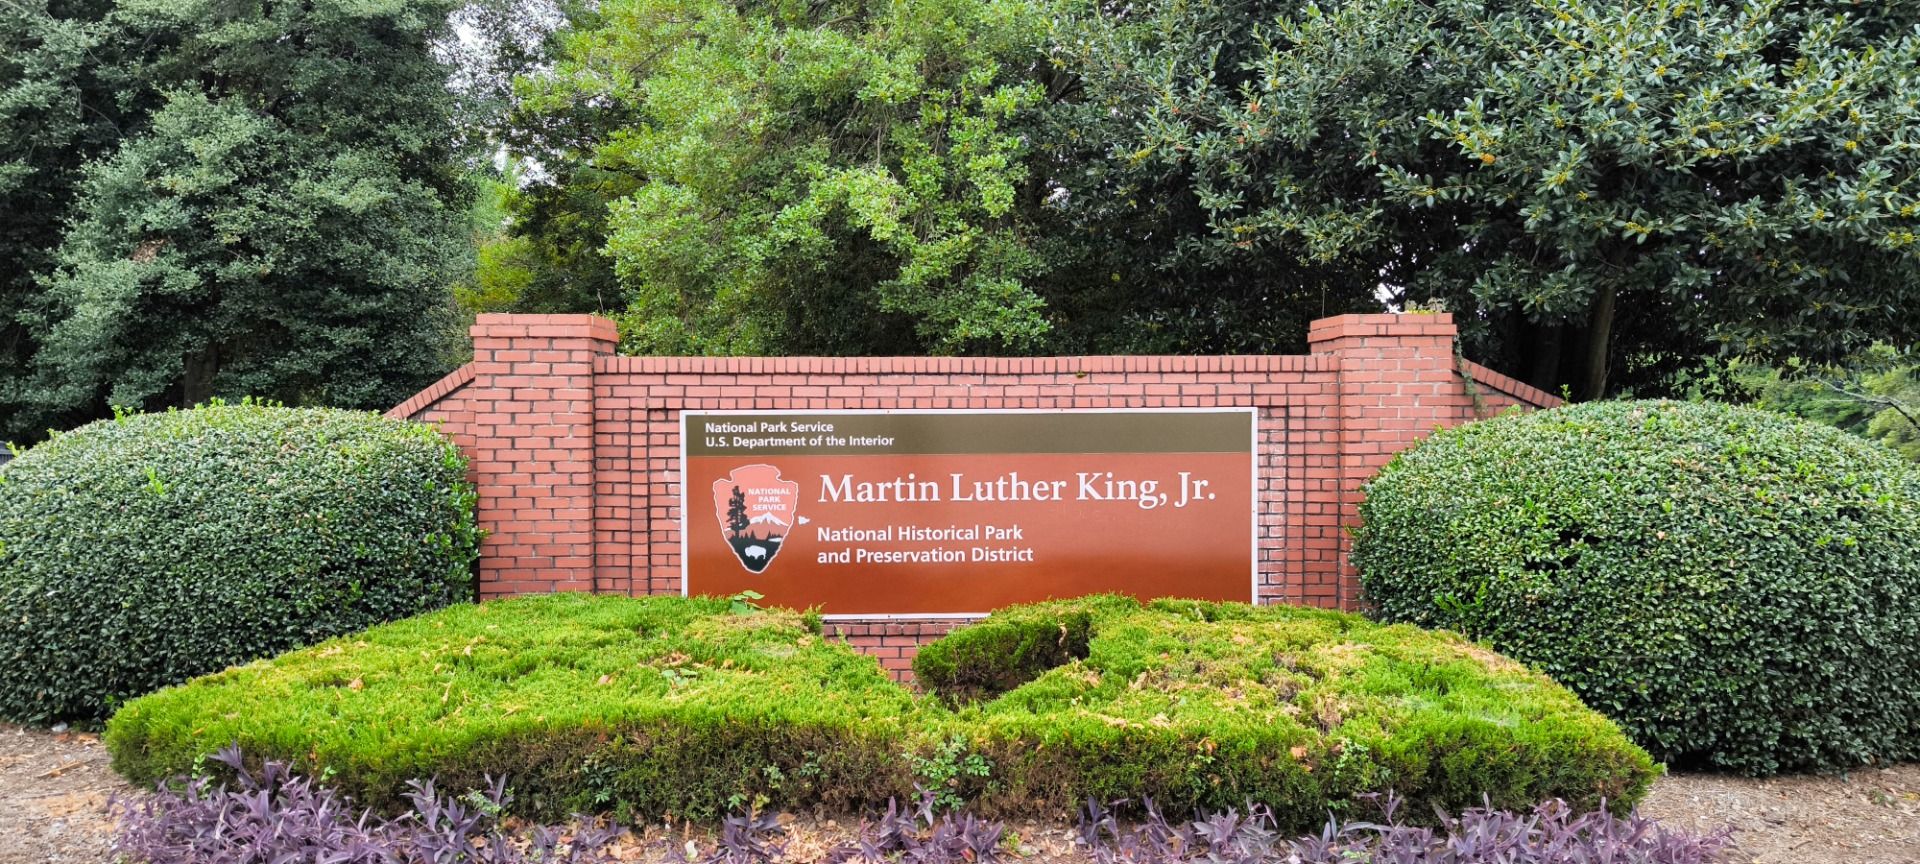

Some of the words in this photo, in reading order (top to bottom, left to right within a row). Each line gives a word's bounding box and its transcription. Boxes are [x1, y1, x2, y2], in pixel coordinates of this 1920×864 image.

[705, 421, 758, 433] National
[761, 421, 788, 433] Park
[791, 421, 834, 433] Service
[705, 436, 730, 448] U.S.
[733, 436, 806, 449] Department
[809, 435, 823, 447] of
[826, 435, 846, 447] the
[850, 435, 894, 447] Interior
[818, 473, 941, 503] Martin
[950, 471, 1067, 502] Luther
[1075, 471, 1168, 510] King,
[1175, 471, 1216, 508] Jr.
[817, 525, 893, 542] National
[898, 524, 979, 542] Historical
[984, 524, 1024, 541] Park
[817, 547, 851, 564] and
[857, 546, 965, 564] Preservation
[972, 546, 1034, 563] District
